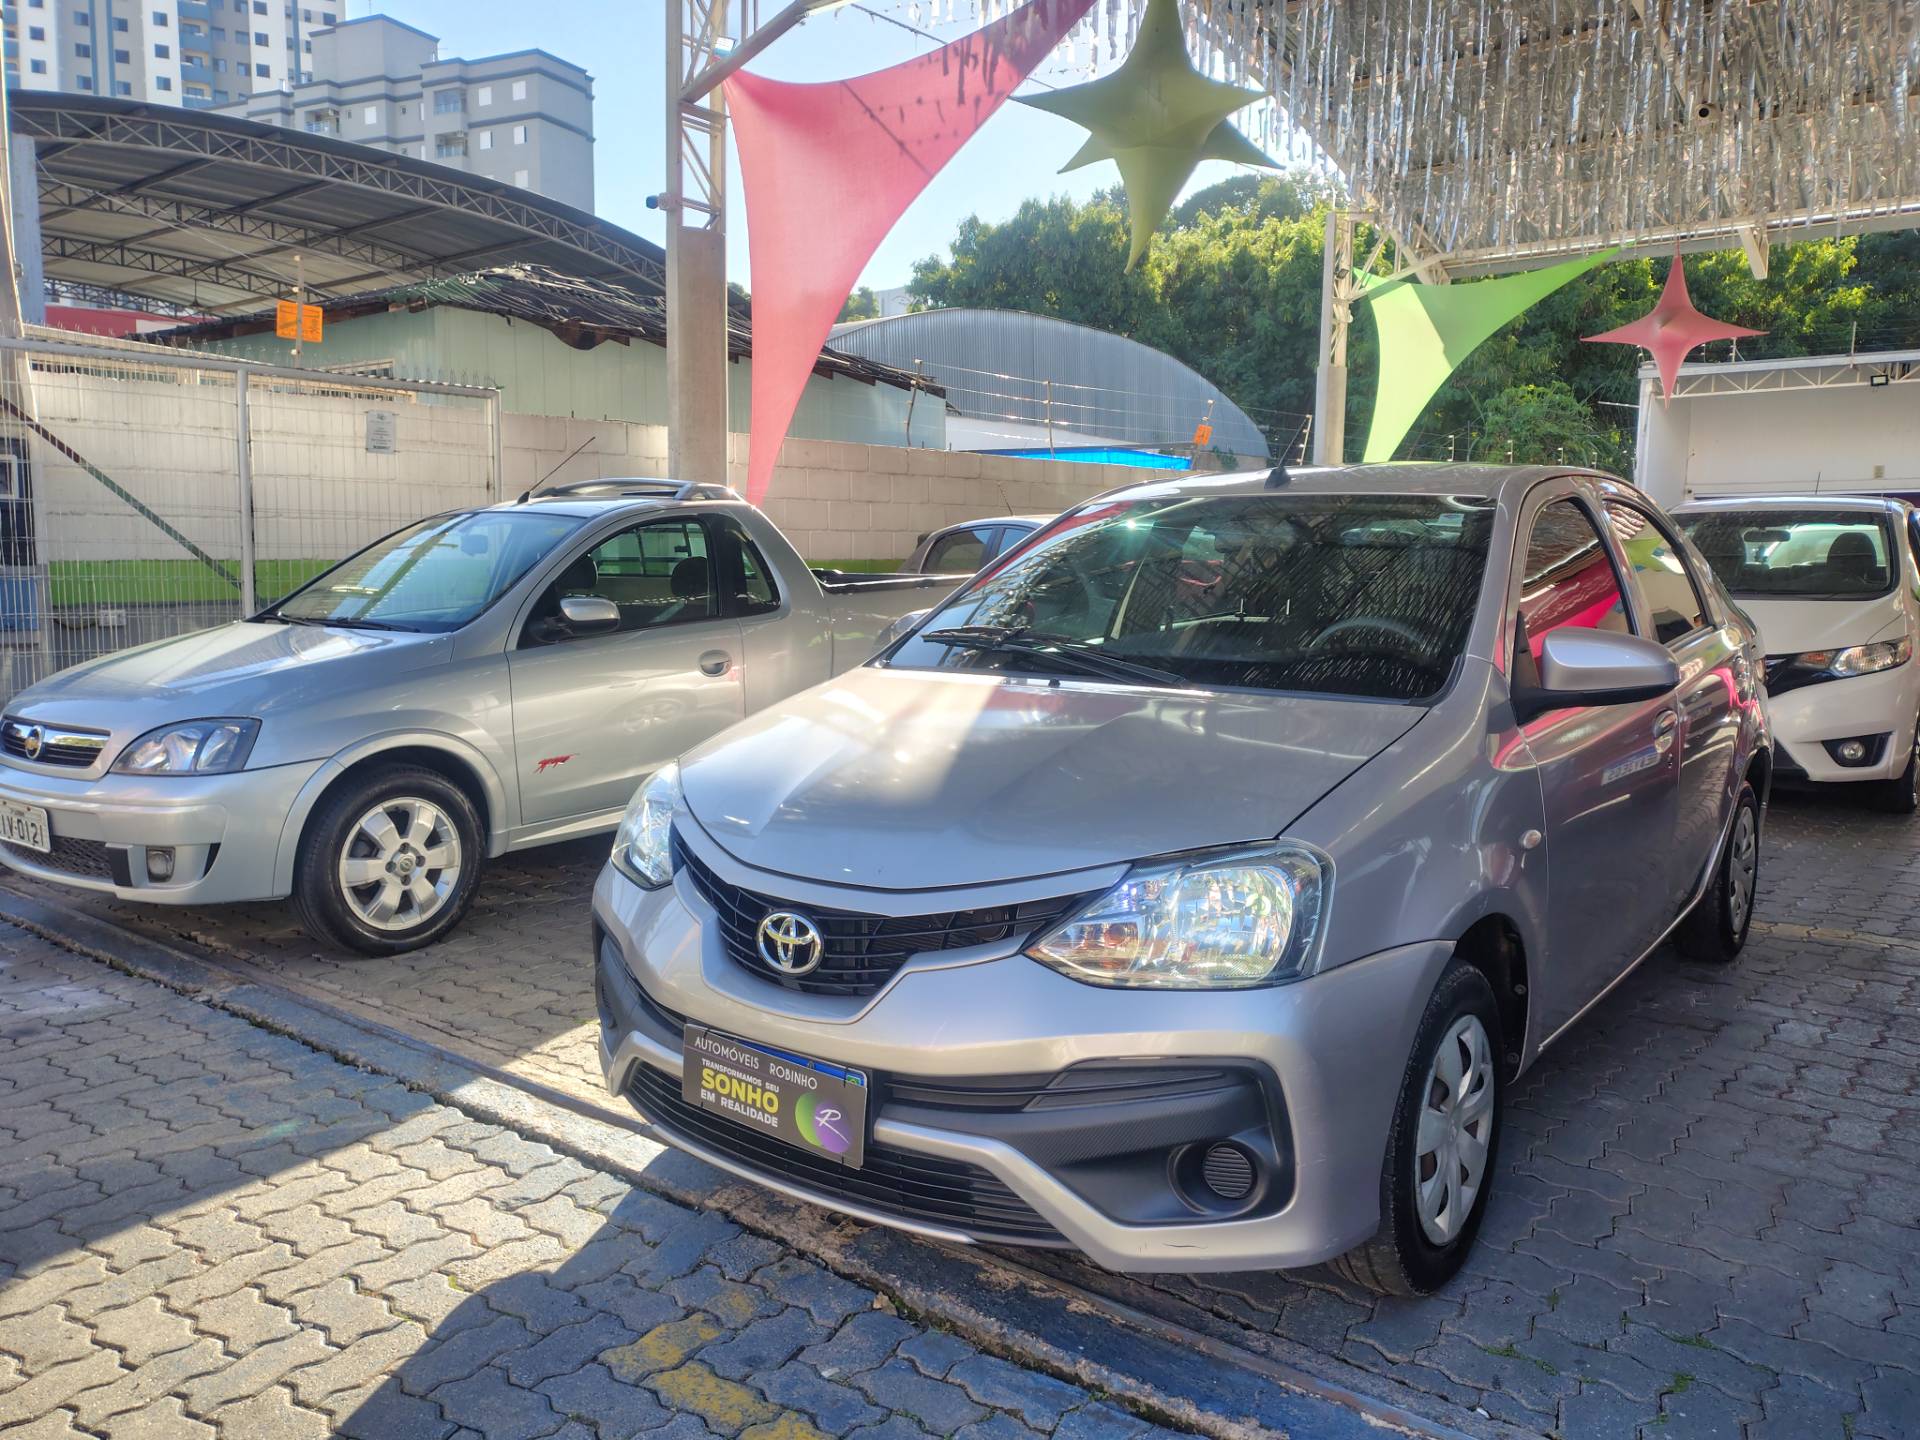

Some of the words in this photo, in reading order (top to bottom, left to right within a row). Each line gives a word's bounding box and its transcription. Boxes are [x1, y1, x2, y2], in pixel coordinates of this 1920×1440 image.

[0, 814, 44, 847] IV-0121
[694, 1036, 760, 1070] AUTOMÓVEIS
[769, 1062, 818, 1090] ROBINHO
[701, 1058, 762, 1086] TRANSFORMAMOS
[765, 1081, 780, 1093] SEU
[700, 1088, 716, 1103] EM
[720, 1096, 779, 1128] REALIDADE
[701, 1067, 779, 1114] SONHO
